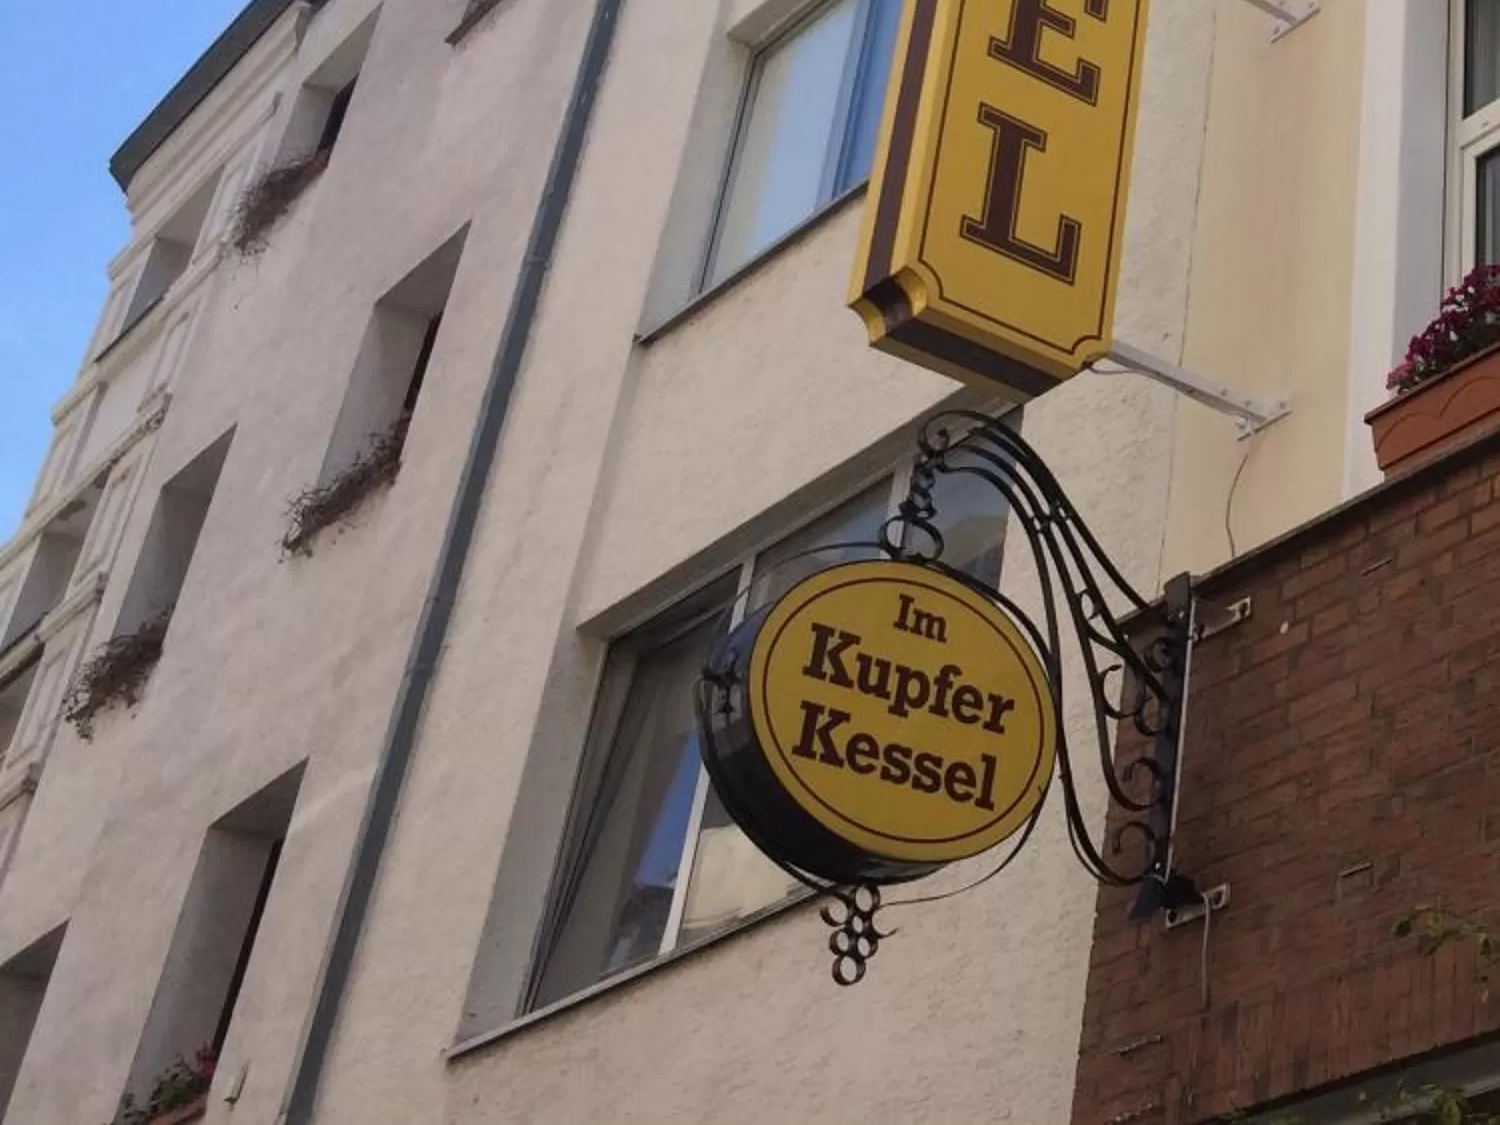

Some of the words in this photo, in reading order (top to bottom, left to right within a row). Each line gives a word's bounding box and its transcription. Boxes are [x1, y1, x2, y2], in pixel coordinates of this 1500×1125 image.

[893, 594, 947, 643] Im
[802, 622, 1015, 734] Kupfer
[792, 700, 997, 811] Kessel
